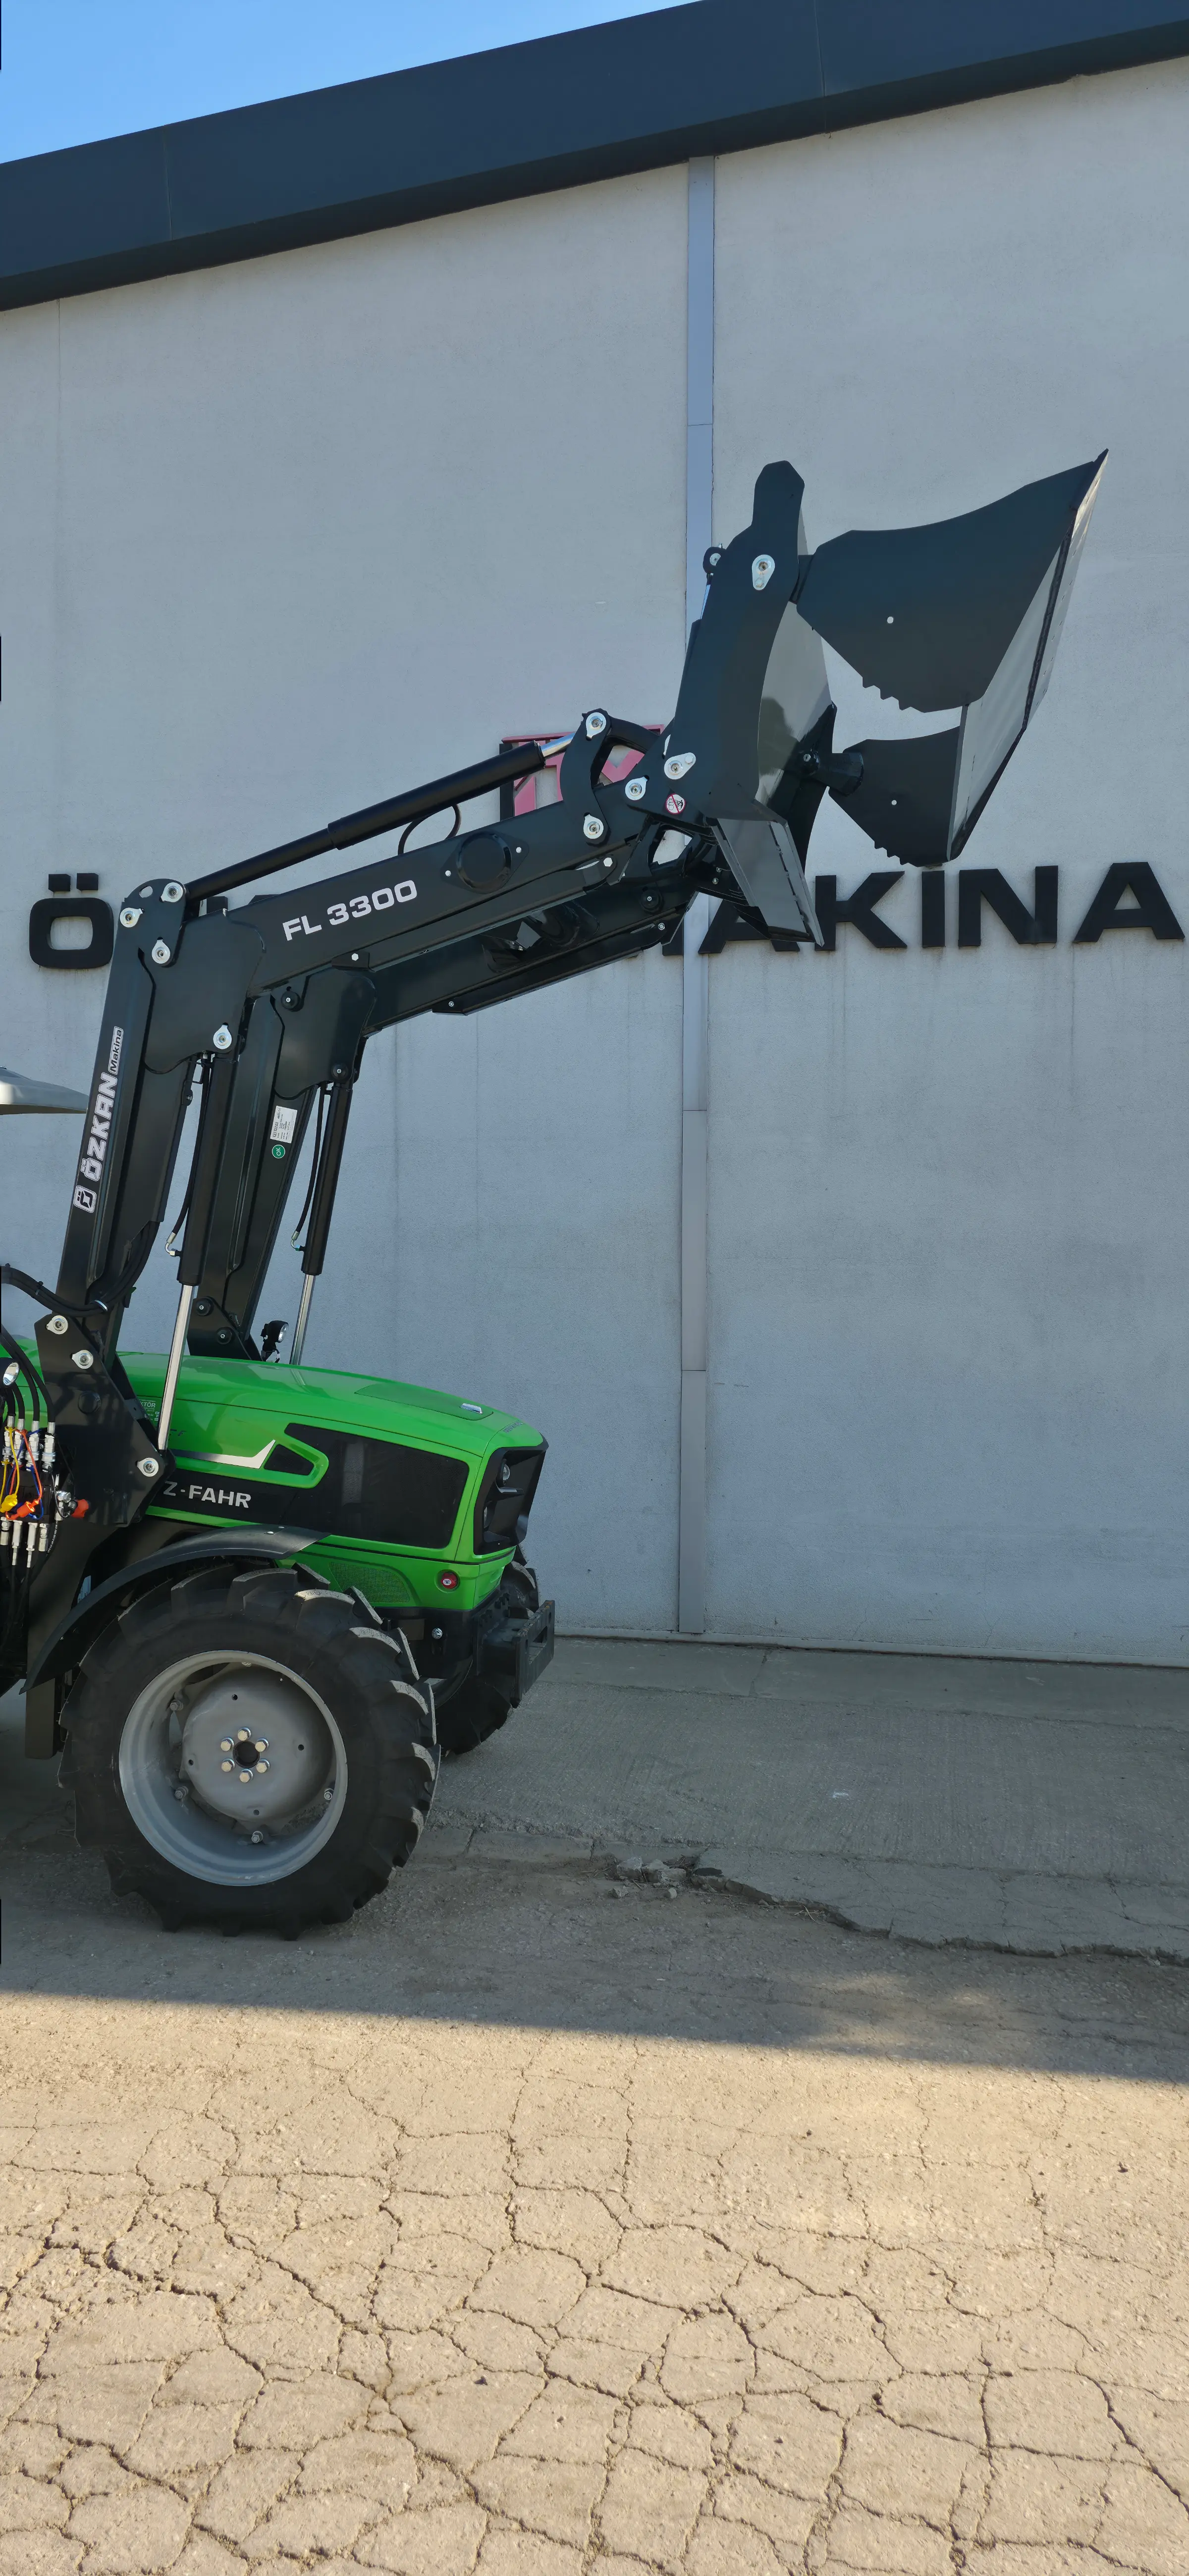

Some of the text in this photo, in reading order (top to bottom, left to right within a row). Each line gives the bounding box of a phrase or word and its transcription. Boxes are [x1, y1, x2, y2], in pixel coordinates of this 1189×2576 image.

[282, 880, 417, 941] FL 3300
[662, 862, 1185, 956] AKINA
[81, 1029, 122, 1181] ÖZKAN Makina
[275, 1147, 281, 1156] OK
